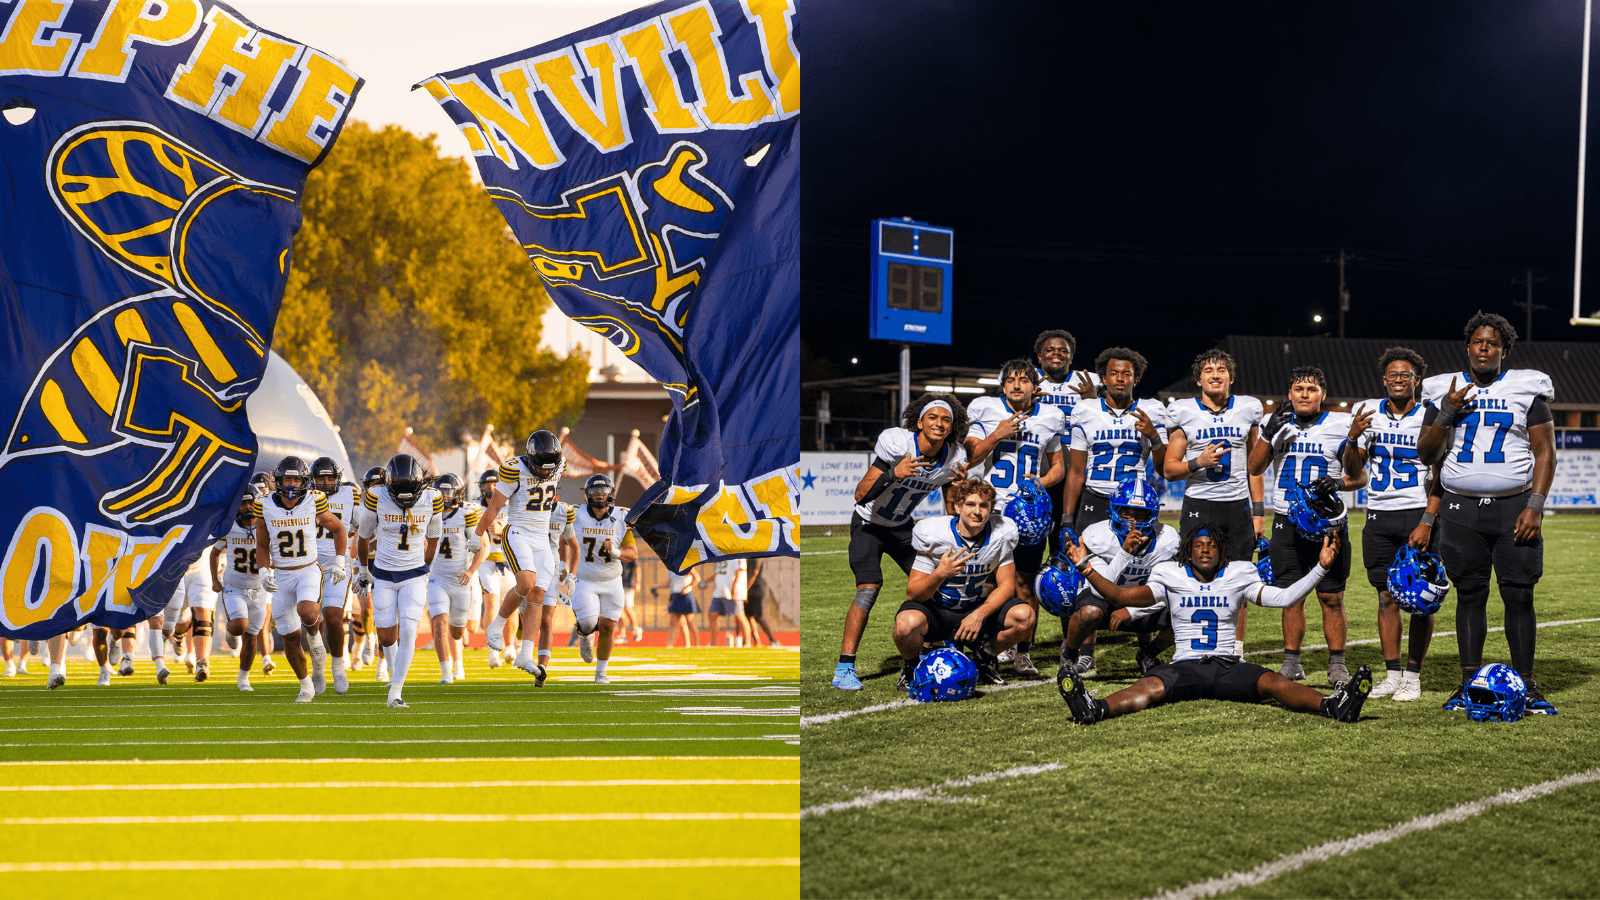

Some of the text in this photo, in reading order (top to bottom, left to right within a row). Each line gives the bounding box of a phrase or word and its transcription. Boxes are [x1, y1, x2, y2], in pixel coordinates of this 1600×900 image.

[1093, 428, 1142, 441] JARRELL
[1195, 426, 1242, 440] JARRELL
[1452, 411, 1514, 463] 77
[1090, 441, 1143, 482] 22
[1278, 442, 1325, 455] JARRELL
[820, 462, 863, 470] LONE STAR
[990, 440, 1041, 488] 50
[1278, 454, 1329, 502] 40
[1368, 443, 1419, 492] 35
[821, 475, 841, 483] BOAT
[525, 484, 556, 512] 22
[877, 486, 929, 522] 11
[271, 517, 310, 528] STEPHENVILLE
[581, 527, 615, 536] STEPHENVILLE
[276, 528, 308, 558] 21
[397, 524, 410, 551] 1
[438, 536, 453, 559] 4
[582, 535, 612, 564] 74
[934, 575, 989, 611] 55
[1179, 595, 1230, 608] JARRELL
[1190, 608, 1219, 651] 3
